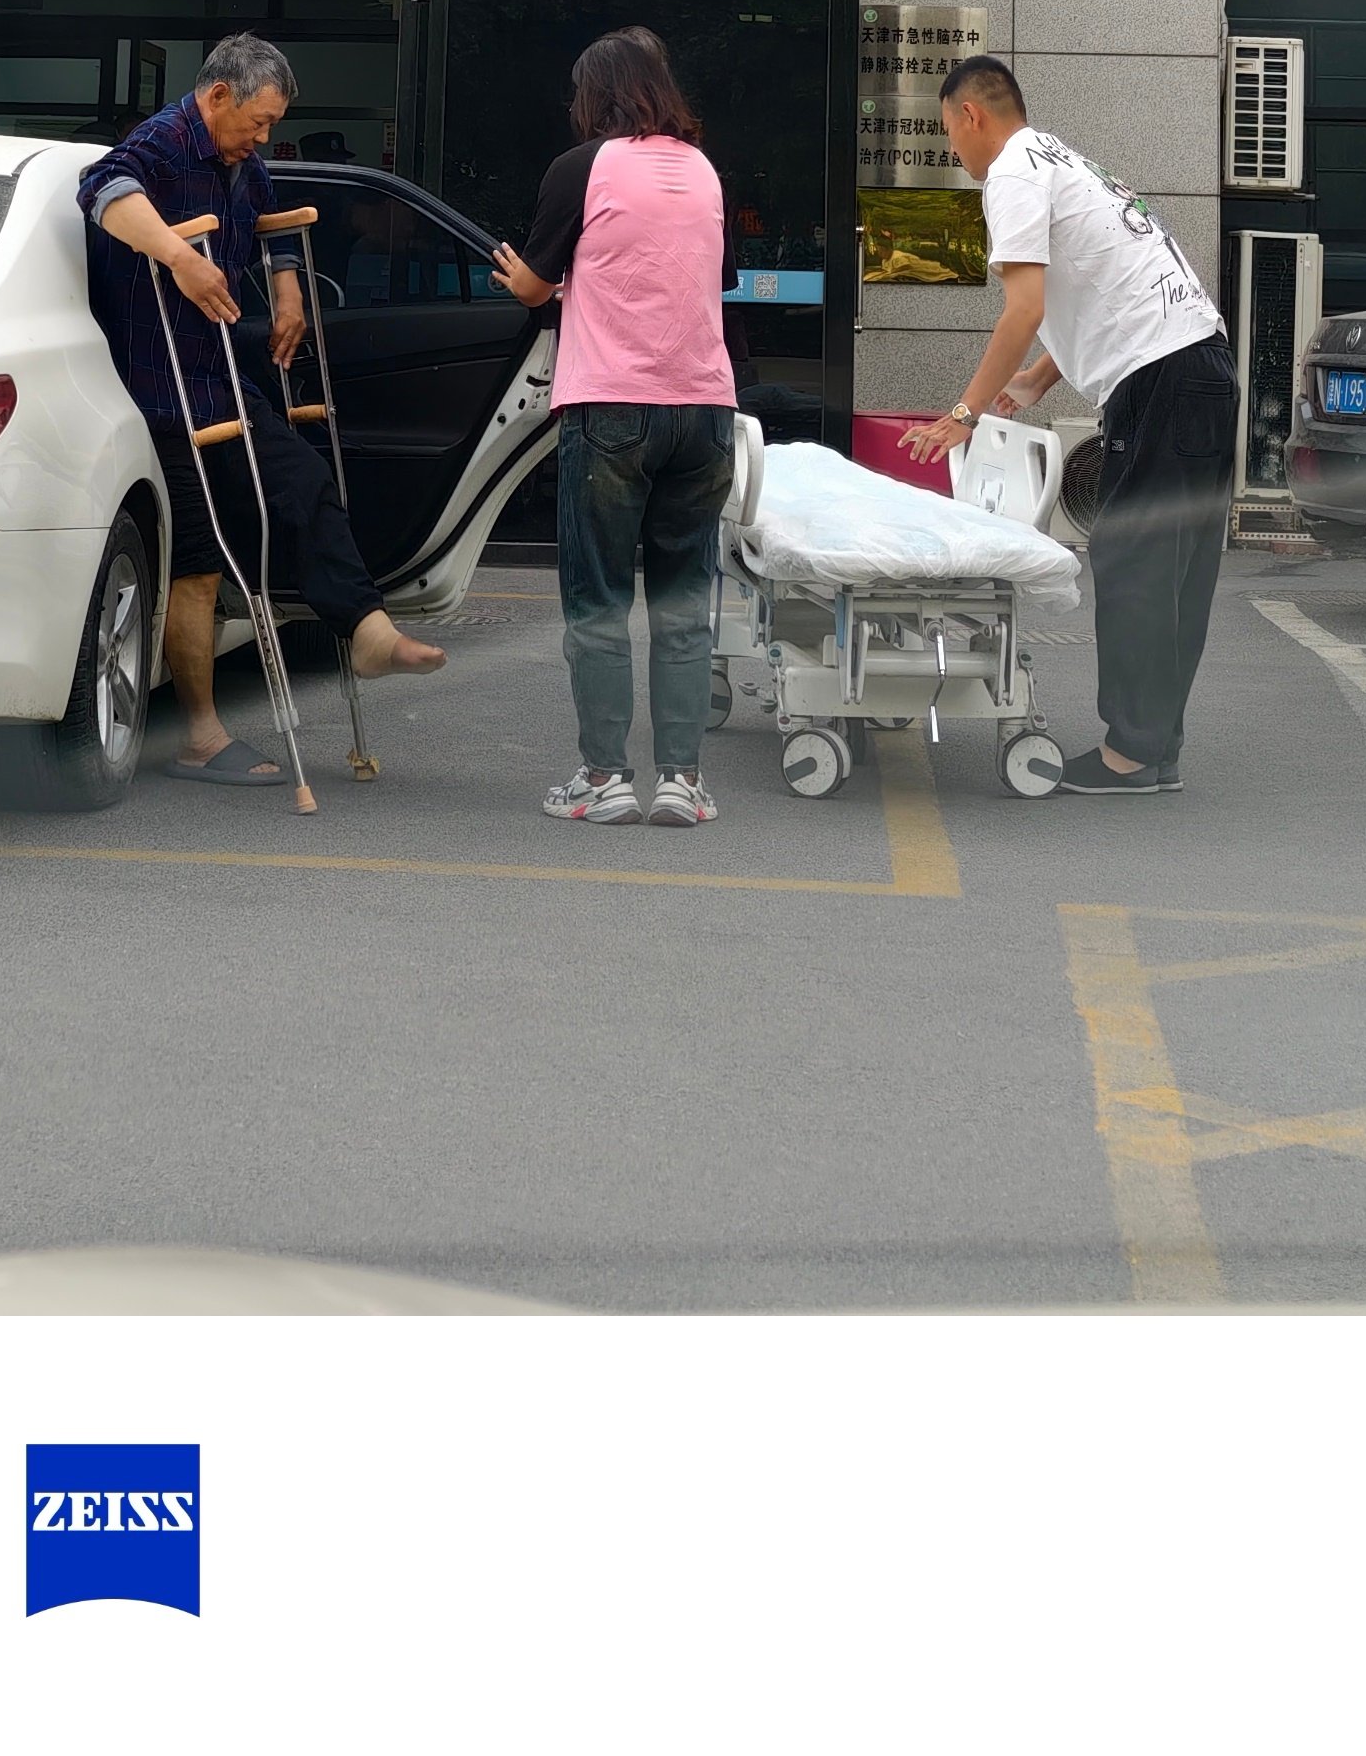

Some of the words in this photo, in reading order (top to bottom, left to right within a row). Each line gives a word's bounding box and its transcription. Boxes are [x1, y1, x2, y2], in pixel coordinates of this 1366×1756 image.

[861, 27, 980, 46] 天津市急性脑卒中
[1150, 271, 1188, 319] The
